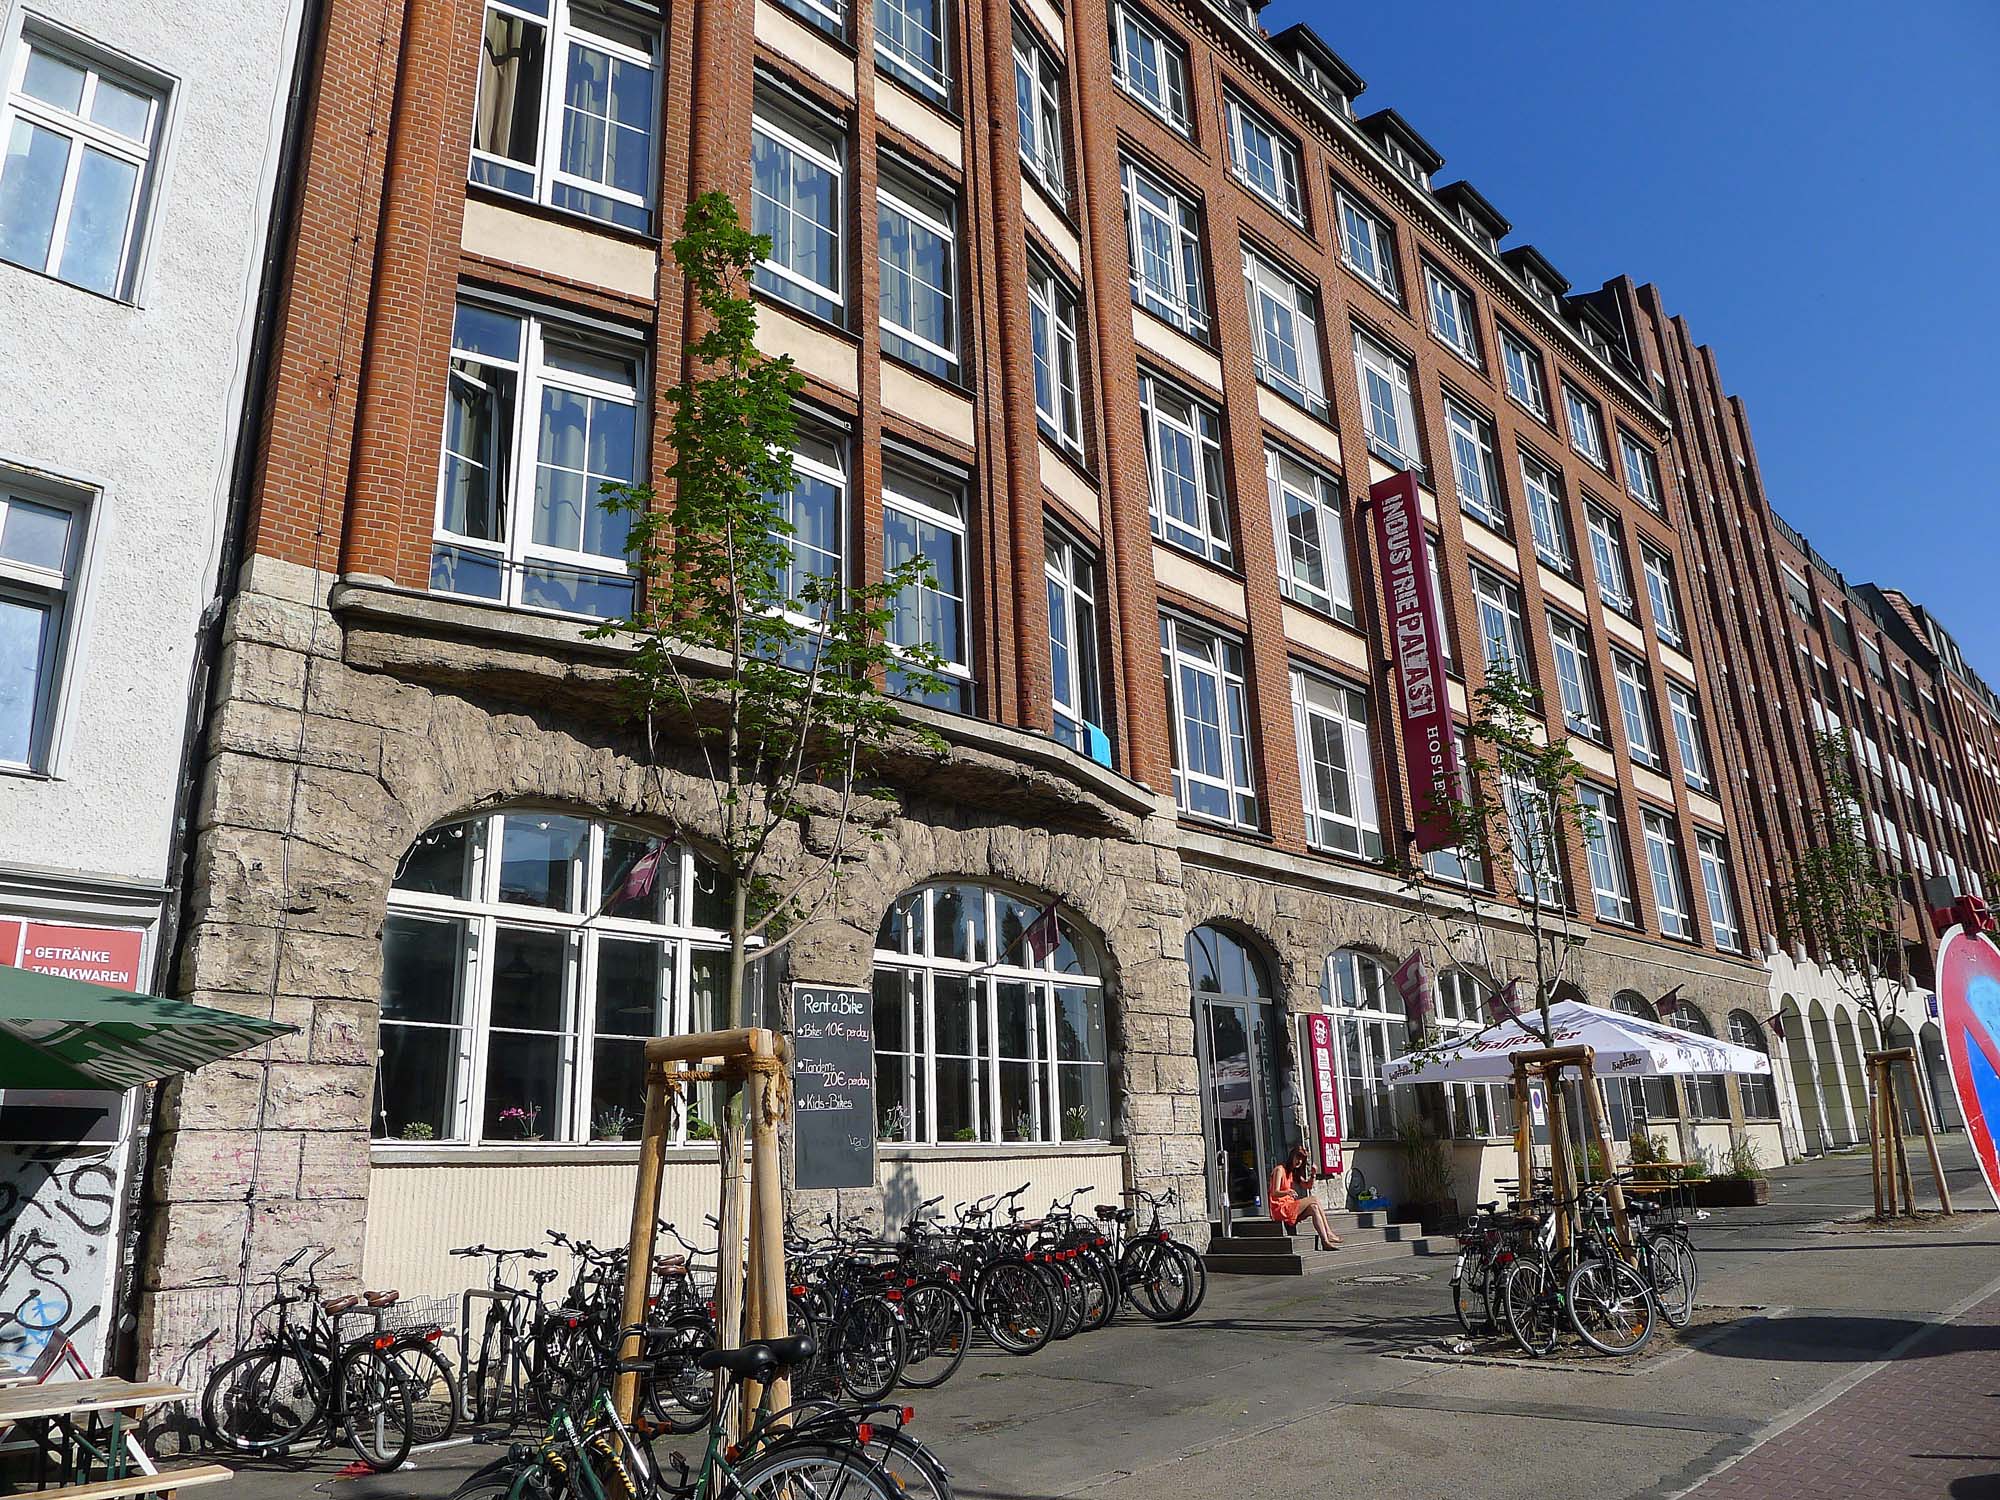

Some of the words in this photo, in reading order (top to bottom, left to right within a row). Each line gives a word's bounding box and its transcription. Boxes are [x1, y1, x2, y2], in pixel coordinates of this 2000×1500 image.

[35, 946, 111, 963] GETRÄNKE
[803, 993, 831, 1014] Rent
[837, 993, 864, 1015] Bike
[825, 1022, 845, 1037] 10€
[1472, 1030, 1581, 1053] Hasserer
[822, 1071, 847, 1087] 20€
